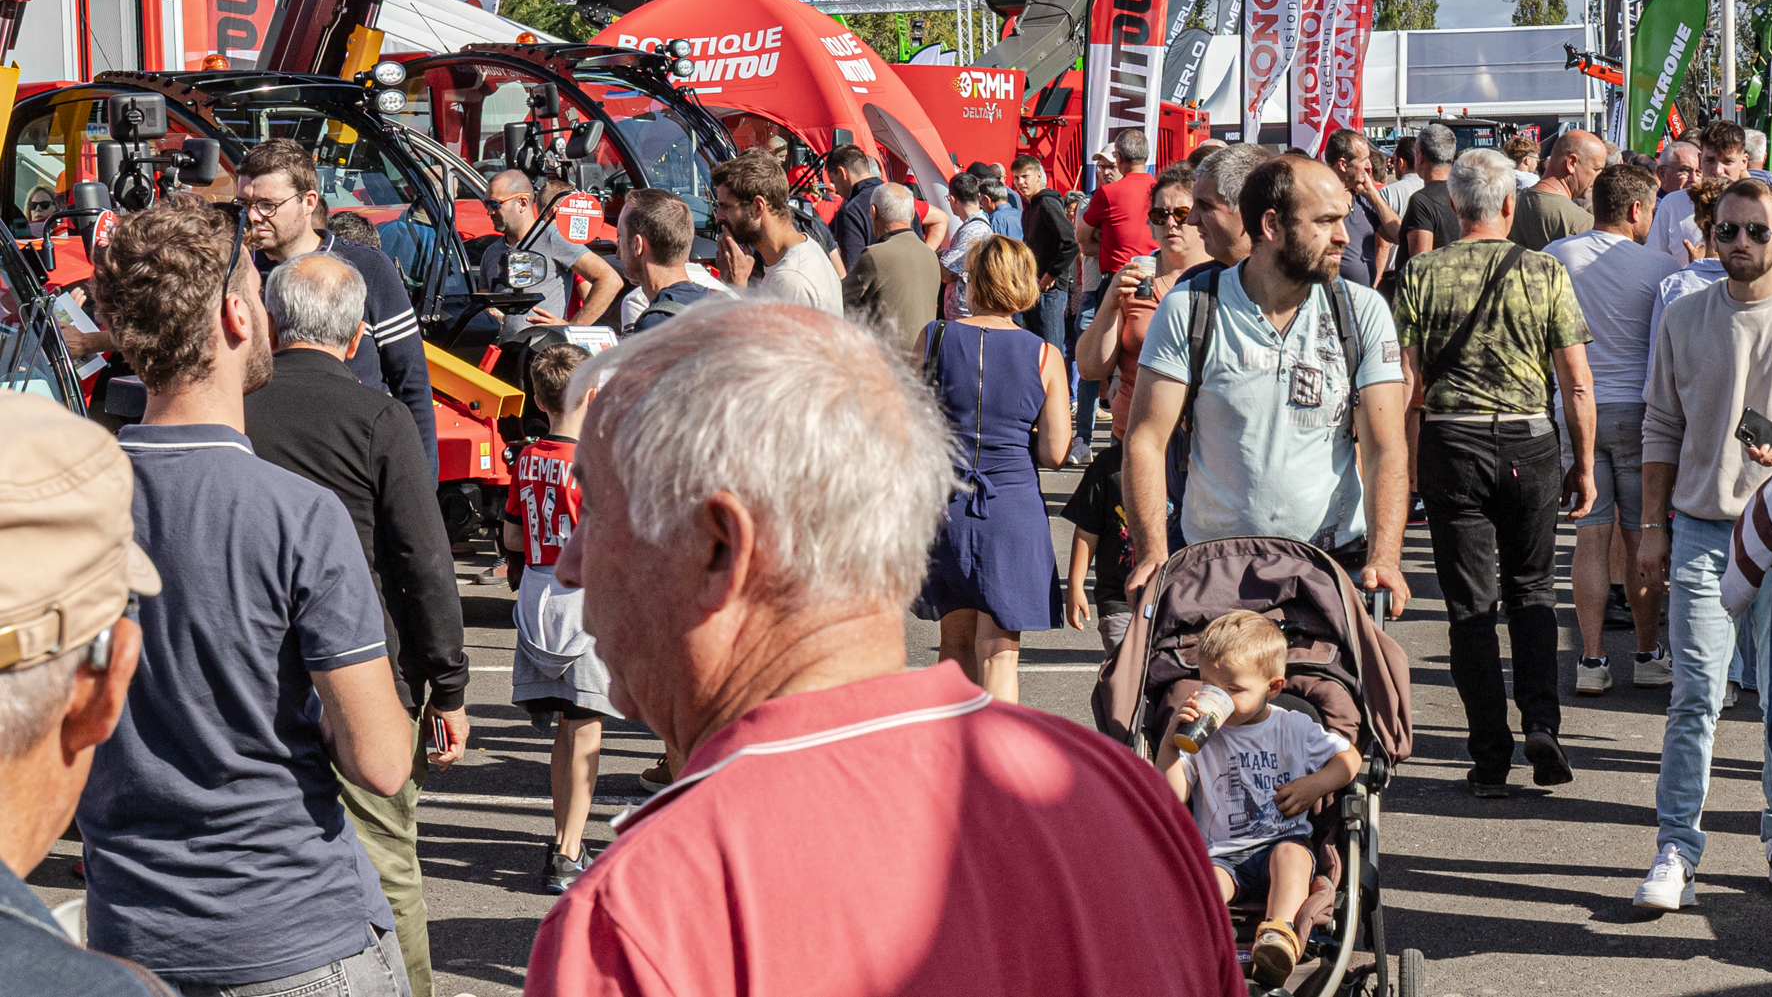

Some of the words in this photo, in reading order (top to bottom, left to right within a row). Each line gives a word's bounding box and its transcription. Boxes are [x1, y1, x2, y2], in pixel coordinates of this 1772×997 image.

[617, 26, 782, 56] BOTIQUE
[1650, 22, 1692, 110] KRONE
[520, 485, 571, 564] 14
[1238, 751, 1278, 771] MAKE
